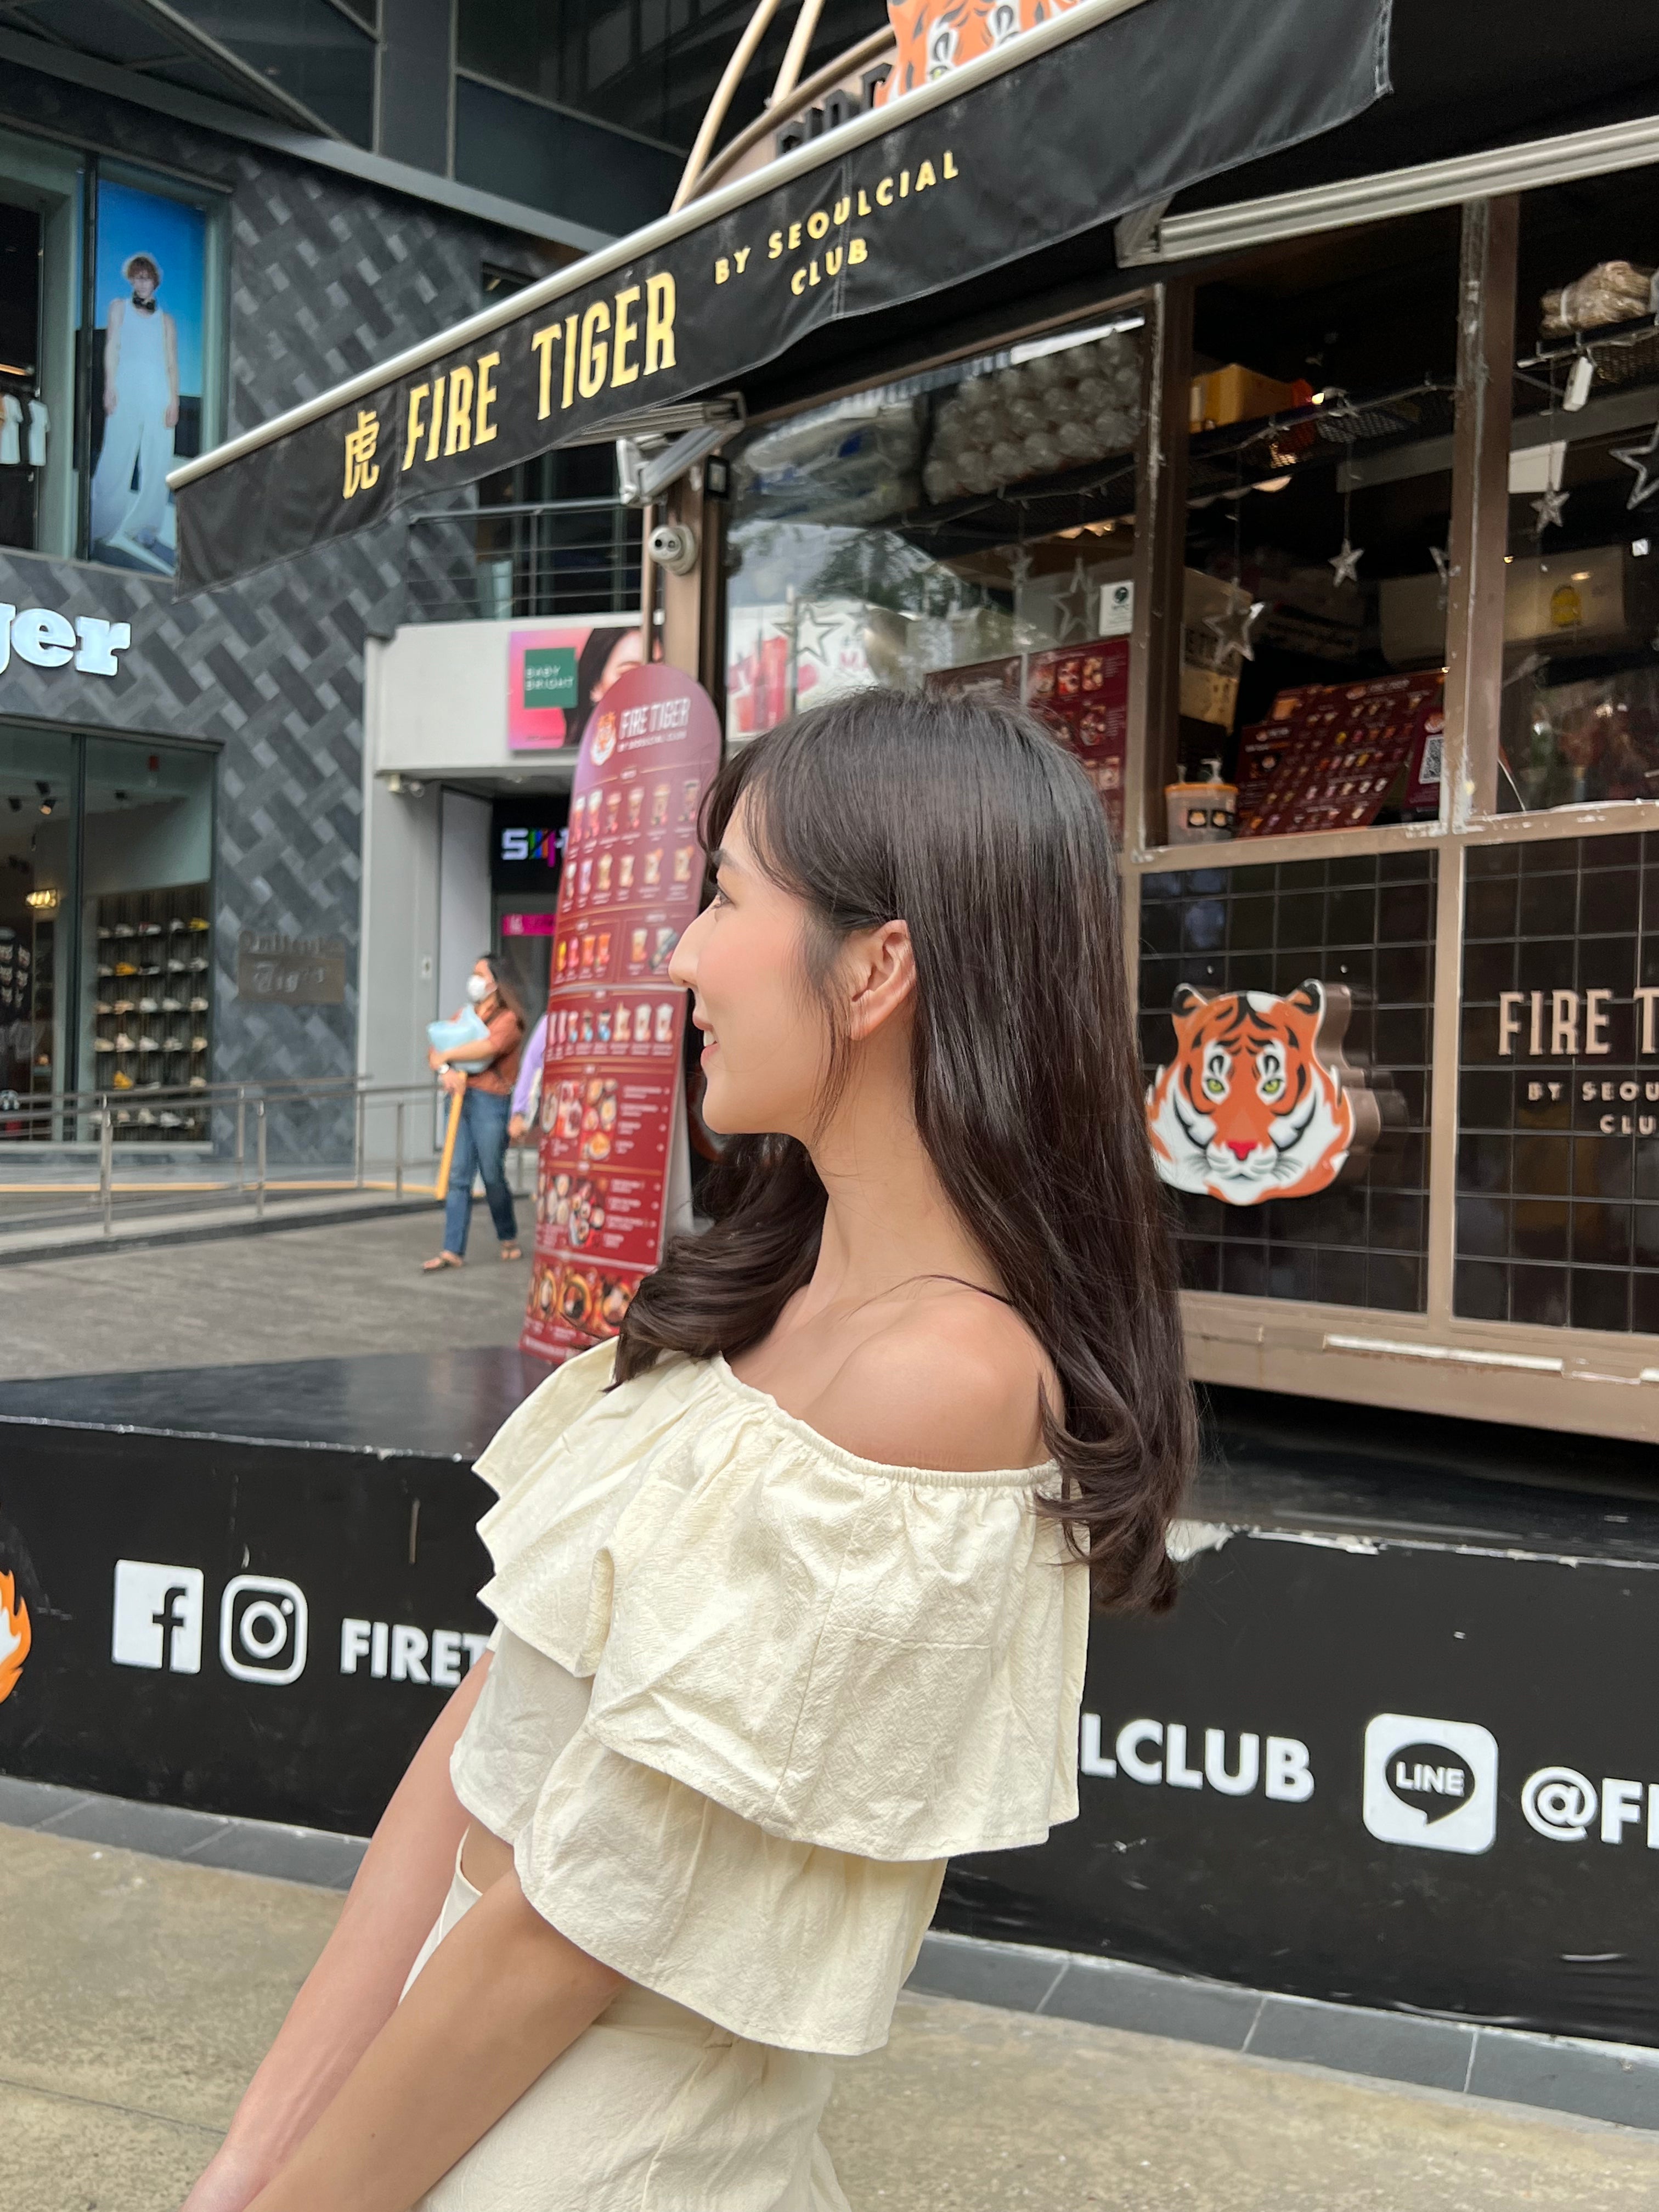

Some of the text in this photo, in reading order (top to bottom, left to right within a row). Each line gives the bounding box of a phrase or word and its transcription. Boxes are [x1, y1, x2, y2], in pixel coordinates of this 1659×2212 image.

[715, 150, 959, 285] BY SEOULCIAL
[791, 238, 868, 296] CLUB
[402, 272, 677, 471] FIRE TIGER
[342, 410, 380, 500] 虎
[0, 602, 131, 676] er
[619, 704, 650, 740] FIRE
[1498, 989, 1613, 1056] FIRE
[1527, 1081, 1659, 1102] BY SEOU
[1599, 1114, 1657, 1136] CLU
[1080, 1712, 1315, 1802] LCLUB
[1395, 1760, 1465, 1797] LINE
